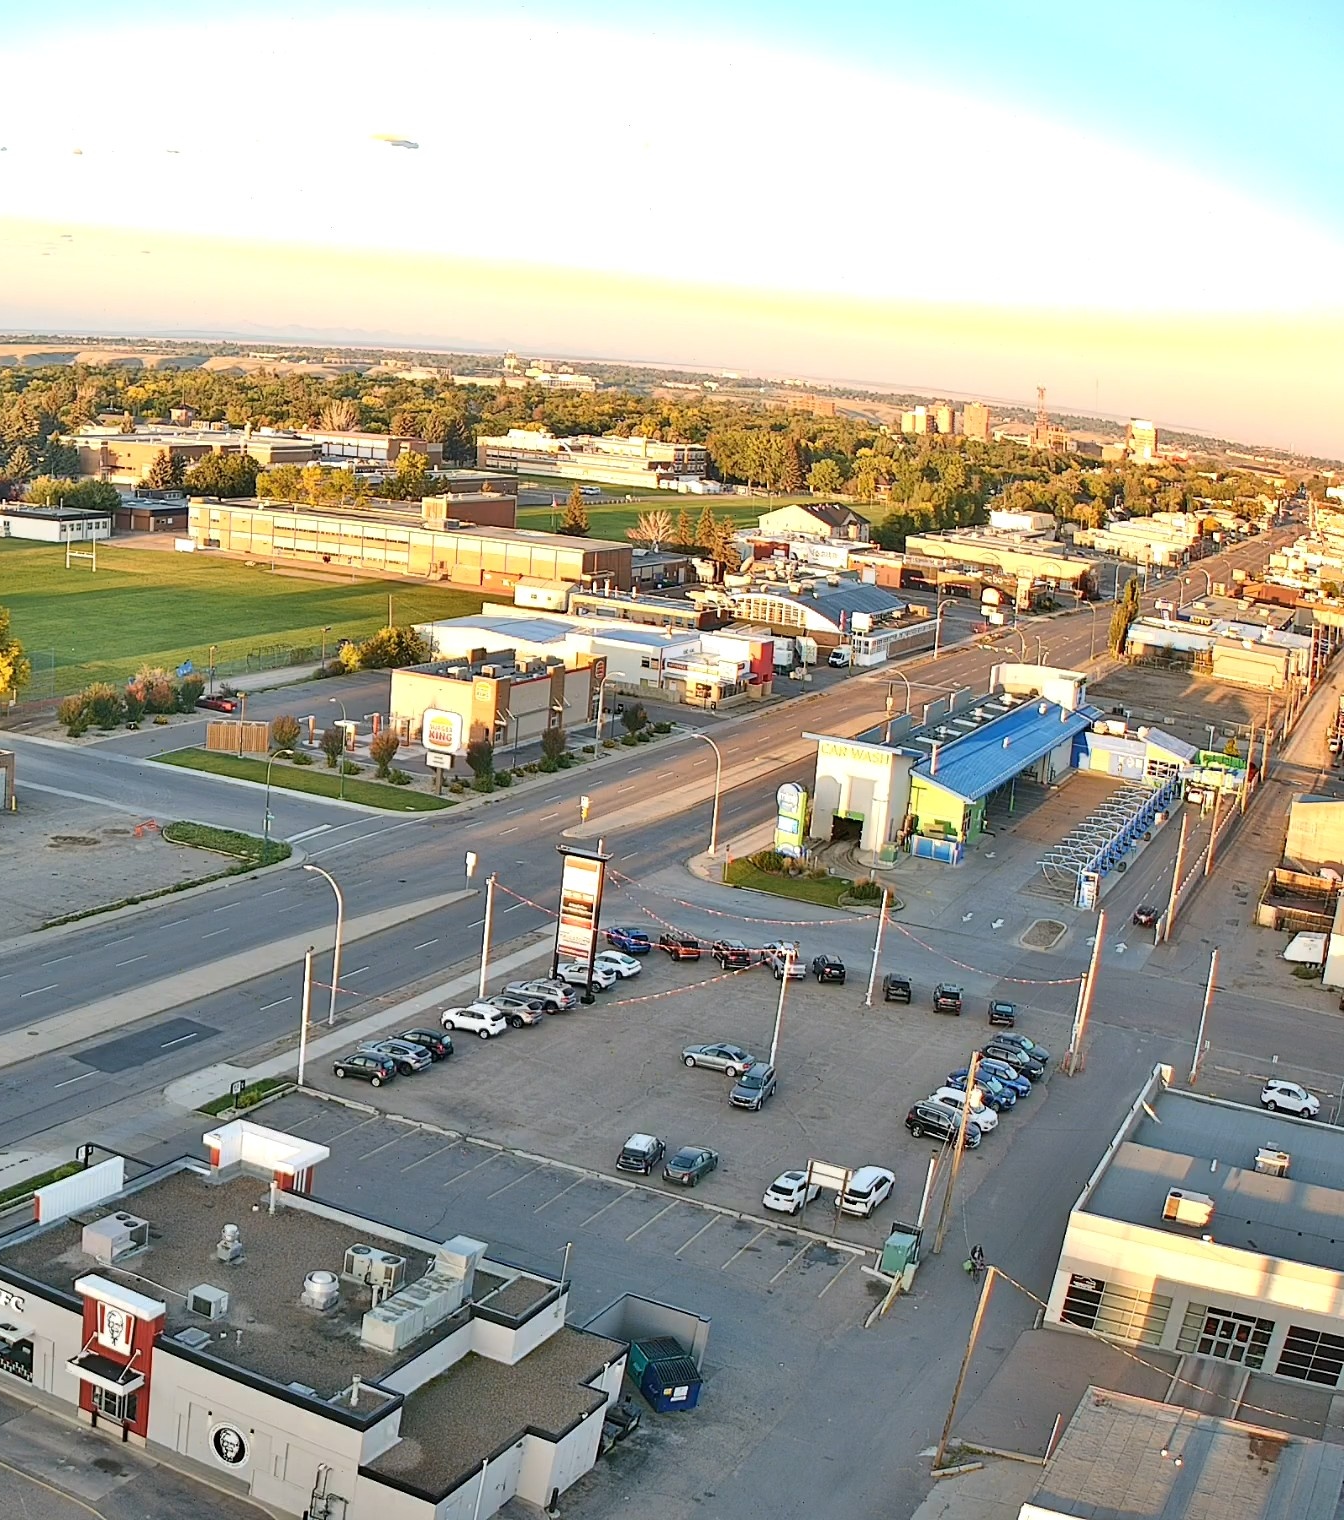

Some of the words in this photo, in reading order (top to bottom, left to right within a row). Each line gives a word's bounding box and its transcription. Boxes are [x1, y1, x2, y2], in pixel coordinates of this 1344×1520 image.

[429, 730, 452, 741] KING
[821, 744, 846, 757] CAR
[852, 750, 890, 764] WASH
